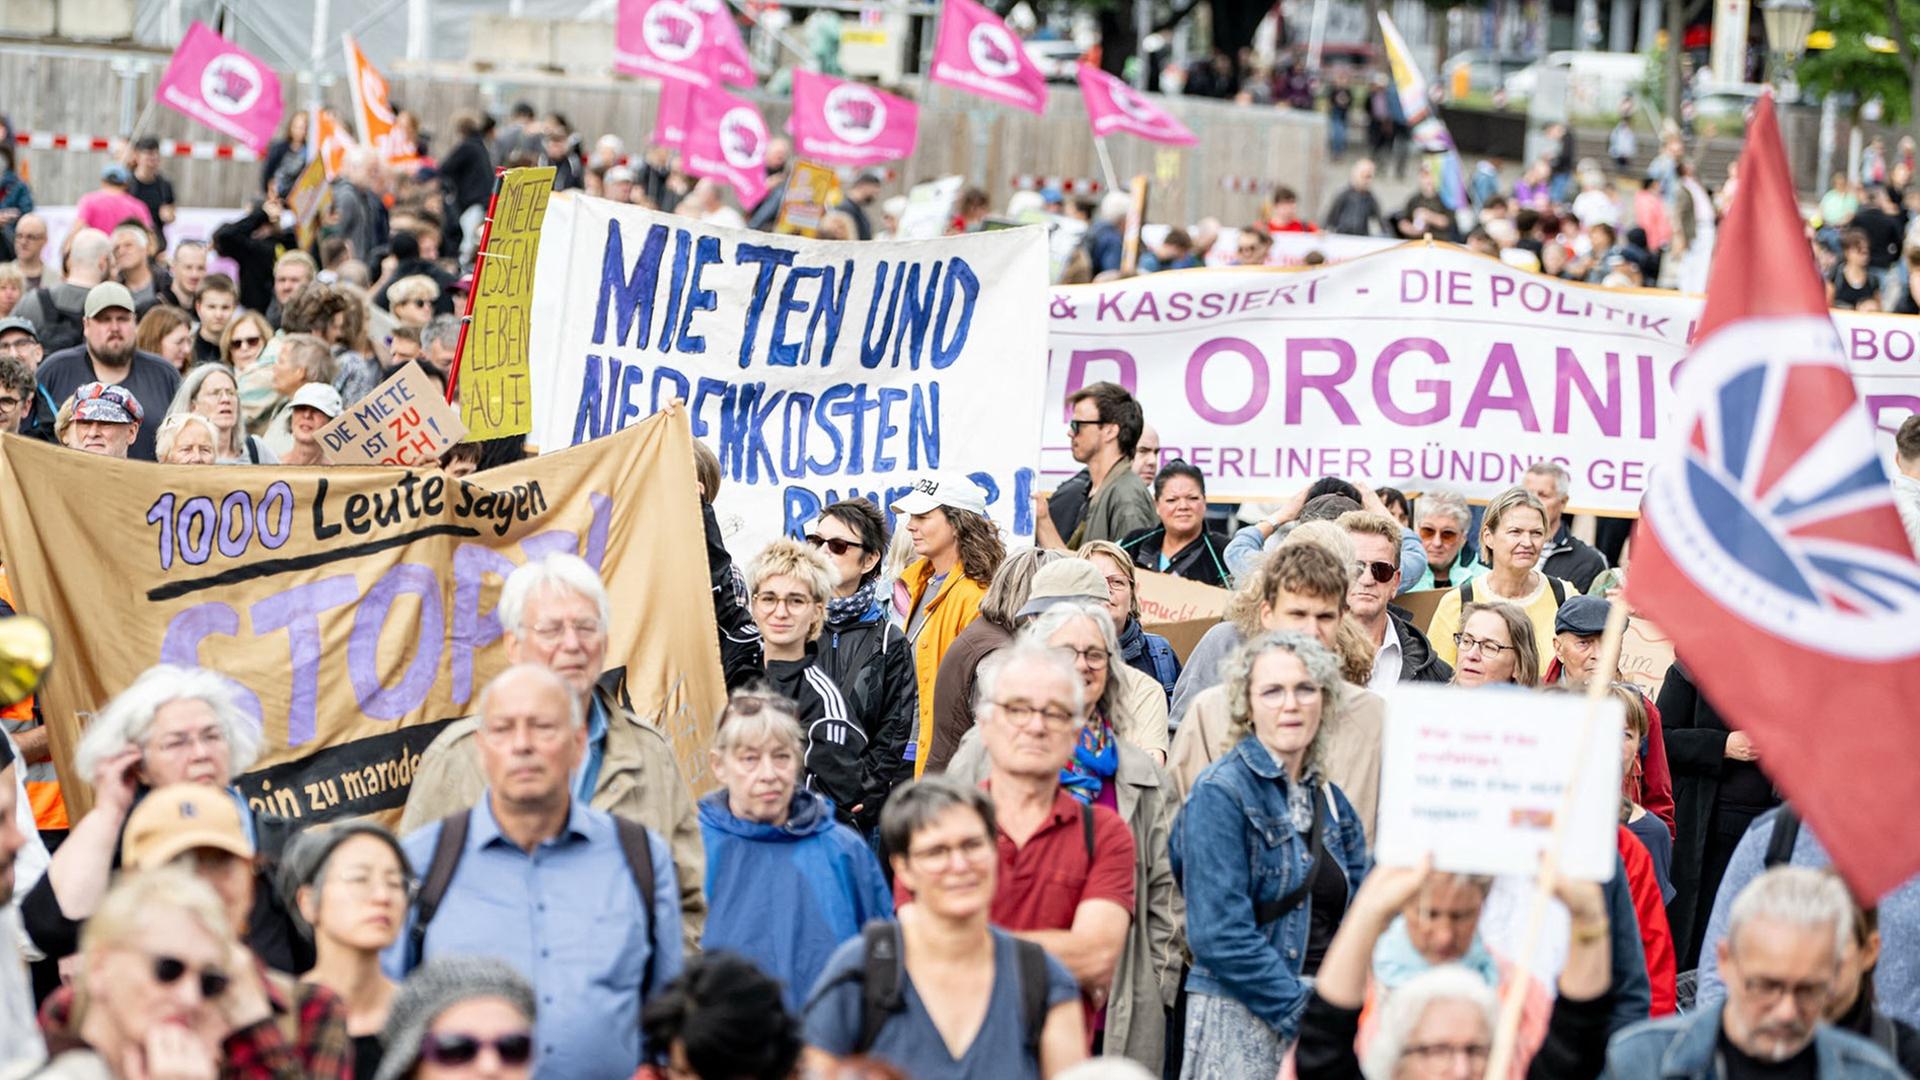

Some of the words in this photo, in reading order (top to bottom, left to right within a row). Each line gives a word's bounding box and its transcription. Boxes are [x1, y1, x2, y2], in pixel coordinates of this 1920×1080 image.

[497, 178, 552, 233] MIETE
[481, 237, 537, 297] ESSEN
[860, 256, 981, 370] UND
[1050, 294, 1078, 320] &
[1095, 275, 1328, 323] KASSIERT
[1400, 269, 1474, 306] DIE
[1490, 274, 1671, 338] POLITIK
[471, 304, 530, 372] LEBEN
[1850, 327, 1920, 363] BO
[323, 420, 358, 452] DIE
[353, 377, 416, 431] MIETE
[1184, 336, 1688, 440] ORGANI
[360, 431, 389, 458] IST
[388, 405, 421, 442] ZU
[1388, 441, 1571, 484] BÜNDN
[1587, 459, 1645, 493] GE
[145, 479, 295, 571] 1000
[312, 470, 445, 541] Leute
[304, 778, 340, 811] zu
